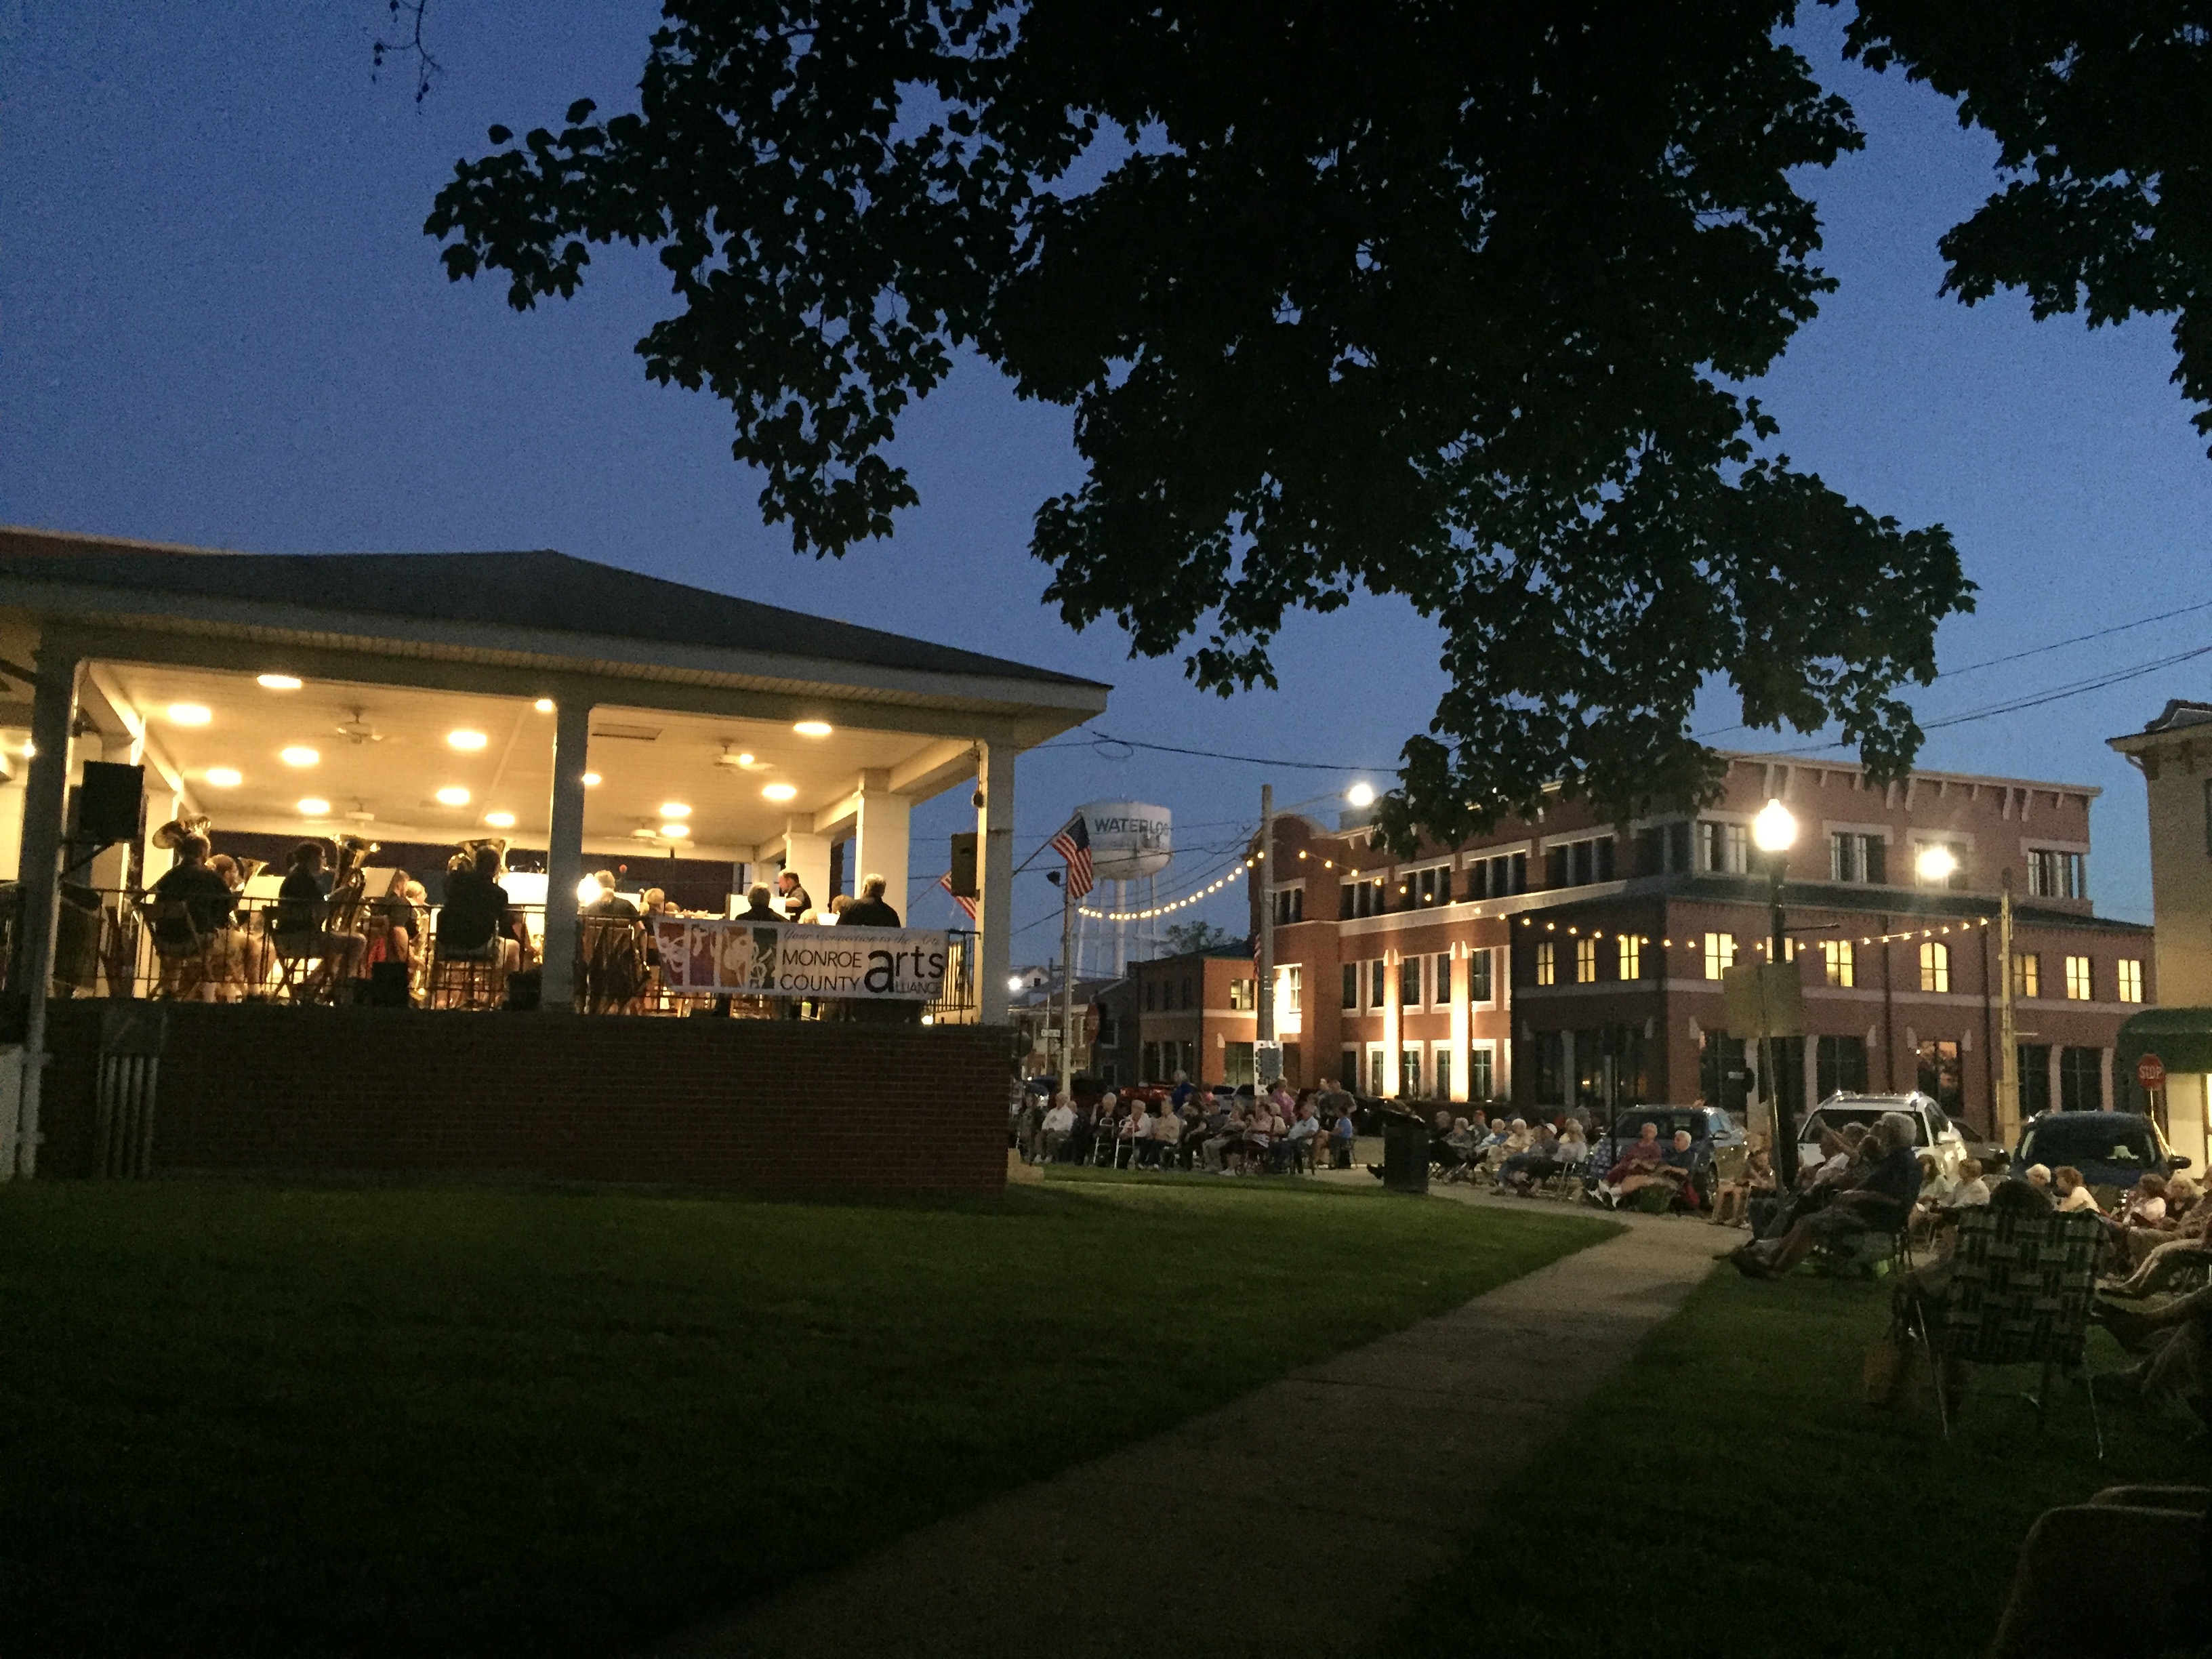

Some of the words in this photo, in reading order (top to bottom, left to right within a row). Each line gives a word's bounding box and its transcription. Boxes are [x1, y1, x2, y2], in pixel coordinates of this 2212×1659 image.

[782, 949, 863, 968] MONROE
[780, 974, 861, 991] COUNTY
[2139, 1065, 2162, 1080] STOP
